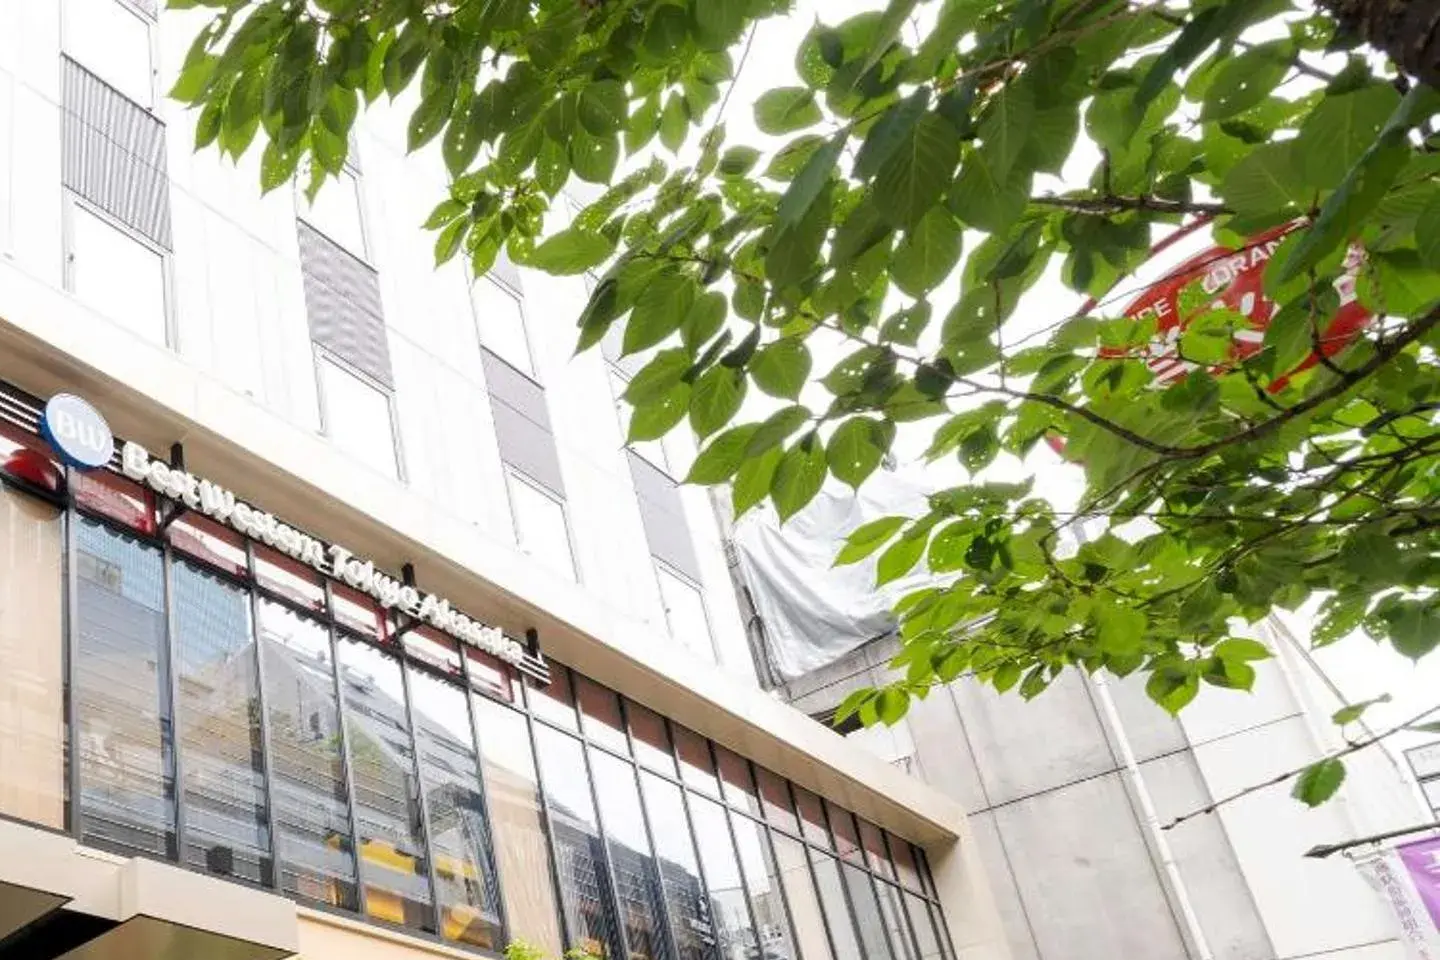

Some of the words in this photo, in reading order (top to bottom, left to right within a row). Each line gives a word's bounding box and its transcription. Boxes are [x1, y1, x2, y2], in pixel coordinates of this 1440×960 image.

[56, 408, 106, 453] BW
[122, 440, 199, 508] Best
[198, 479, 326, 568] Western
[328, 544, 419, 612] Tokyo
[418, 593, 524, 665] Akasaka
